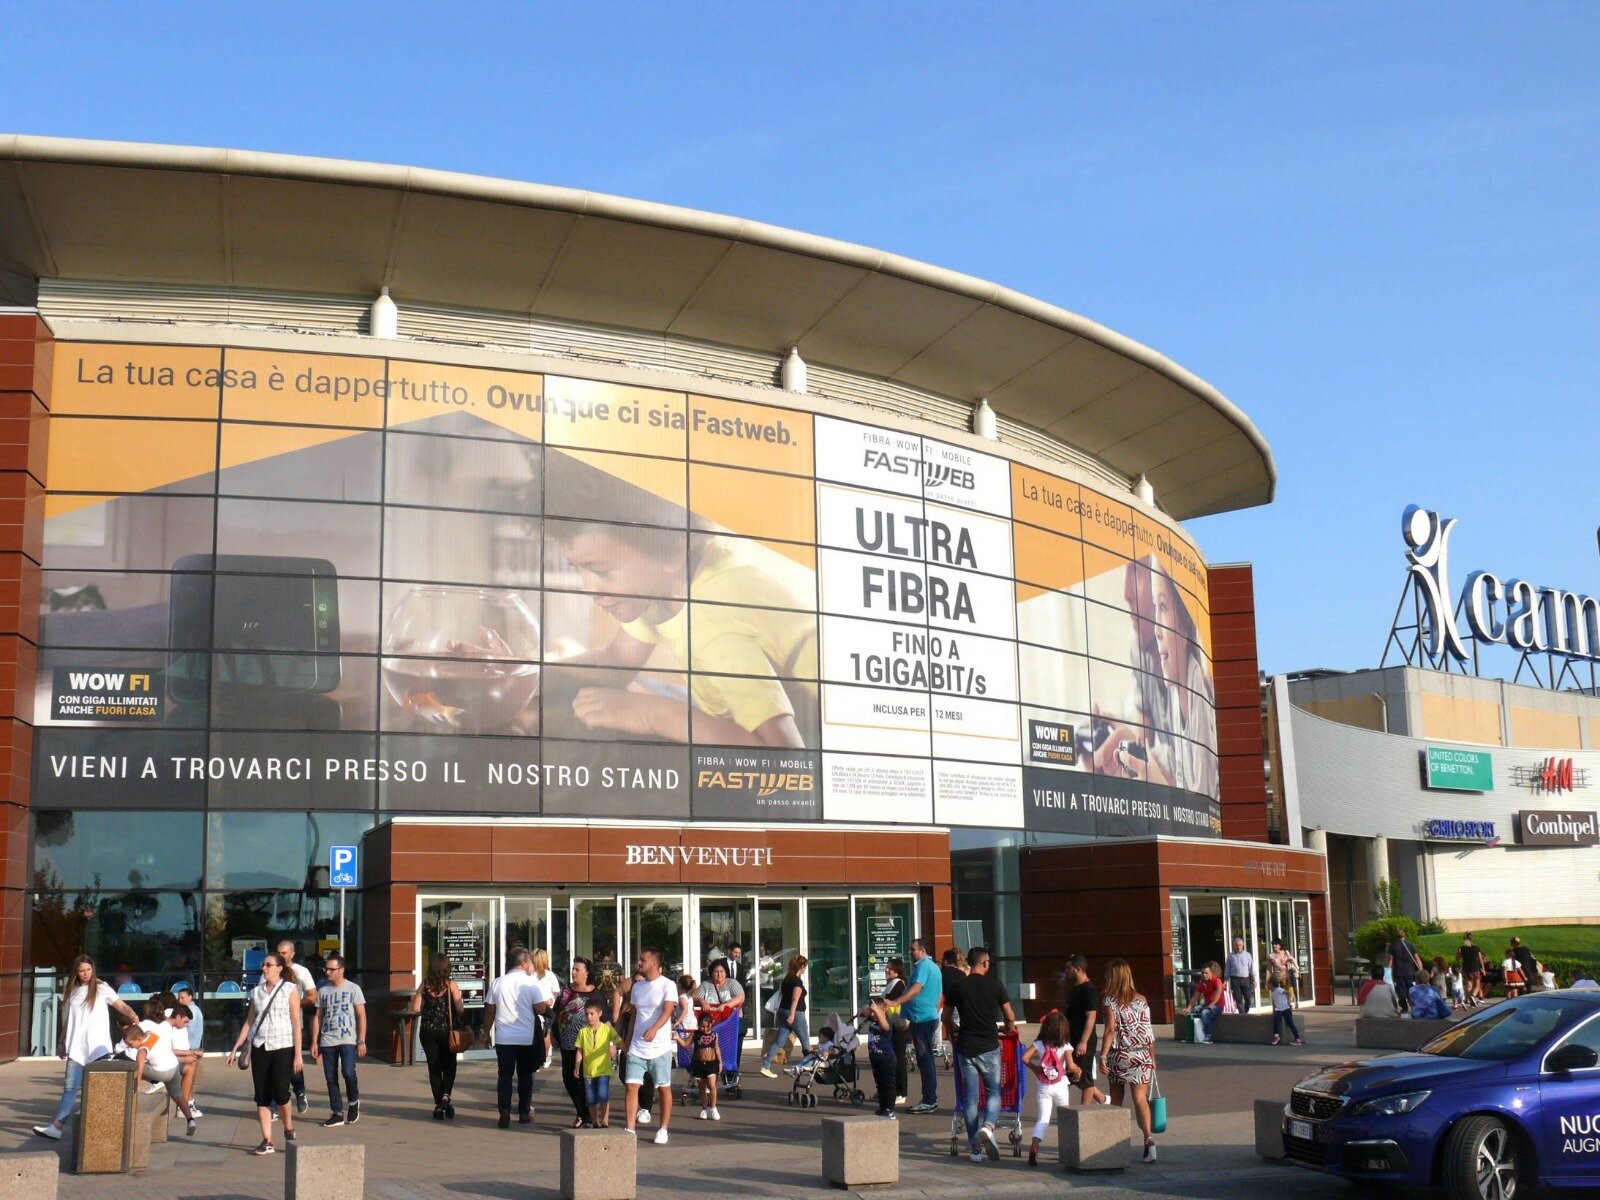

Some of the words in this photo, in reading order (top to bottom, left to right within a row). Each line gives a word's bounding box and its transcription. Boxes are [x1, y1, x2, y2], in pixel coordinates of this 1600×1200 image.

[77, 358, 114, 384] La
[125, 361, 174, 387] tua
[185, 366, 257, 391] casa
[268, 365, 285, 391] è
[295, 367, 476, 407] dappertutto.
[487, 384, 609, 423] Ovunque
[618, 400, 640, 425] ci
[648, 404, 686, 431] sia
[692, 408, 798, 447] Fastweb.
[863, 433, 891, 447] FIBRA
[896, 440, 919, 453] WOW
[925, 445, 933, 456] FI
[942, 450, 972, 466] MOBILE
[863, 449, 976, 491] FASTWEB
[1022, 478, 1039, 501] La
[1041, 486, 1063, 509] tua
[1066, 496, 1093, 520] casa
[1095, 502, 1101, 523] è
[1103, 507, 1156, 549] dappertutto.
[856, 506, 978, 569] ULTRA
[862, 565, 976, 624] FIBRA
[892, 631, 942, 657] FINO
[948, 639, 960, 661] A
[69, 672, 125, 691] WOW
[129, 674, 150, 692] FI
[850, 652, 987, 696] 1GIGABIT/s
[58, 695, 80, 704] CON
[82, 696, 106, 705] GIGA
[107, 697, 158, 706] ILLIMITATI
[59, 706, 94, 715] ANCHE
[95, 706, 126, 716] FUORI
[129, 707, 157, 717] CASA
[873, 704, 909, 717] INCLUSA
[910, 707, 926, 718] PER
[935, 709, 944, 719] 12
[945, 711, 963, 721] MESI
[1034, 725, 1059, 741] WOW
[1059, 728, 1069, 742] FI
[697, 757, 725, 766] FIBRA
[735, 758, 757, 767] WOW
[761, 759, 770, 768] FI
[780, 760, 814, 769] MOBILE
[1033, 750, 1048, 759] ANCHE
[1061, 753, 1073, 761] CASA
[1430, 751, 1453, 762] UNITED
[1454, 752, 1479, 764] COLORS
[51, 755, 128, 778] VIENI
[141, 756, 158, 779] A
[171, 757, 311, 780] TROVARCI
[325, 758, 428, 782] PRESSO
[443, 761, 466, 784] IL
[488, 763, 589, 787] NOSTRO
[601, 767, 679, 790] STAND
[1430, 762, 1440, 772] OF
[697, 770, 814, 797] FASTWEB
[768, 799, 790, 807] passo
[1033, 789, 1066, 810] VIENI
[1070, 793, 1078, 810] A
[1081, 794, 1129, 816] TROVARCI
[1132, 801, 1161, 819] PRESSO
[1163, 807, 1170, 821] IL
[1173, 806, 1194, 824] NOSTRO
[1194, 811, 1209, 828] STAND
[1465, 820, 1496, 838] SPORT
[1526, 813, 1596, 842] Conbipel
[335, 849, 352, 871] P
[625, 845, 774, 867] BENVENUTI
